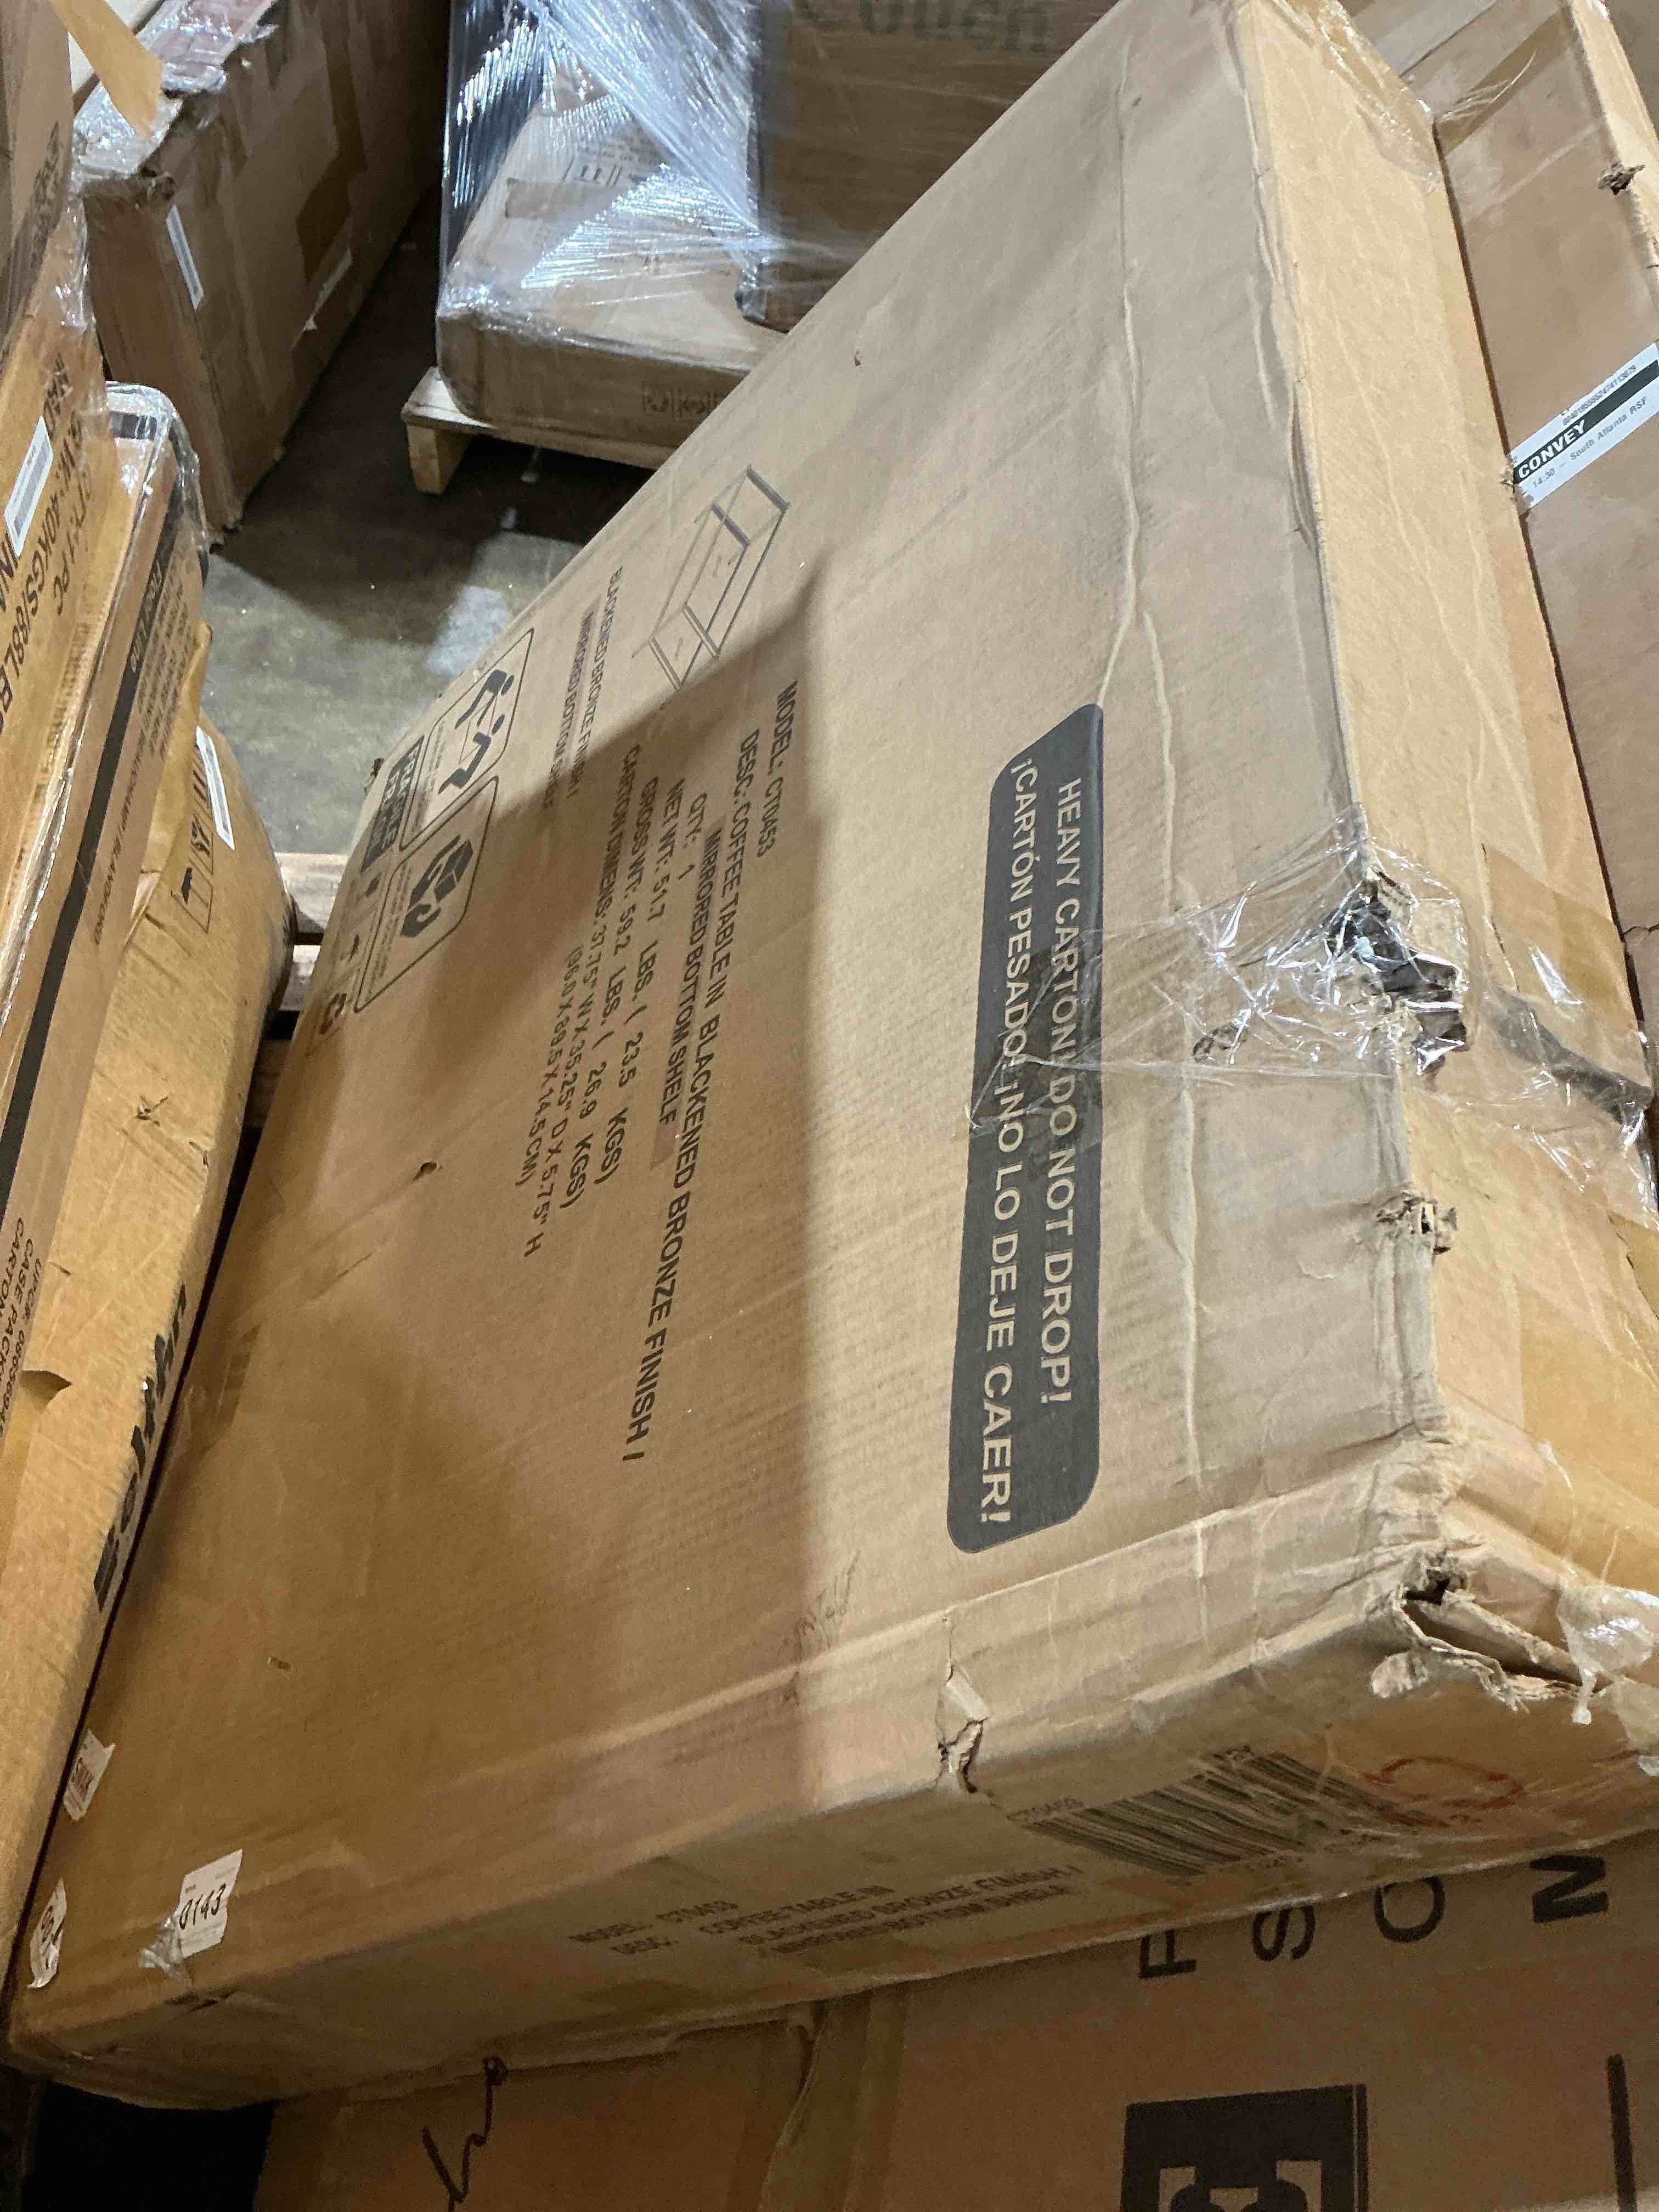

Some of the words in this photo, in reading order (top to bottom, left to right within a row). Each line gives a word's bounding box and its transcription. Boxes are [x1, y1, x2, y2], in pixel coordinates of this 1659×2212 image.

[1518, 419, 1585, 478] CONVEY
[580, 660, 605, 734] BRONZE
[768, 680, 798, 775] MODEL:
[610, 743, 641, 836] CARTON
[631, 776, 659, 856] GROSS
[662, 777, 685, 826] NET
[682, 792, 708, 850] QTY:
[721, 801, 751, 899] COFFEE
[1056, 777, 1082, 887] HEAVY
[647, 873, 671, 922] 51.7
[689, 828, 723, 945] MIRRORED
[612, 904, 637, 957] 59.2
[710, 891, 741, 979] TABLE
[600, 965, 627, 1027] LBS.
[631, 940, 658, 1002] LBS.
[672, 943, 704, 1045] BOTTOM
[703, 978, 726, 1010] IN
[579, 1062, 607, 1119] 26.9
[619, 1031, 644, 1089] 23.5
[659, 1045, 688, 1125] SHELF
[551, 1117, 568, 1139] D
[674, 1013, 721, 1189] BLACKENED
[1048, 1073, 1077, 1138] DO
[560, 1132, 594, 1209] KGS)
[594, 1107, 629, 1186] KGS)
[994, 1161, 1023, 1221] LO
[1043, 1146, 1076, 1237] NOT
[523, 1232, 544, 1257] H
[648, 1190, 691, 1328] BRONZE
[985, 1230, 1019, 1352] DEJE
[1039, 1251, 1074, 1406] DROP!
[625, 1328, 667, 1447] FINISH
[980, 1362, 1014, 1526] CAER!
